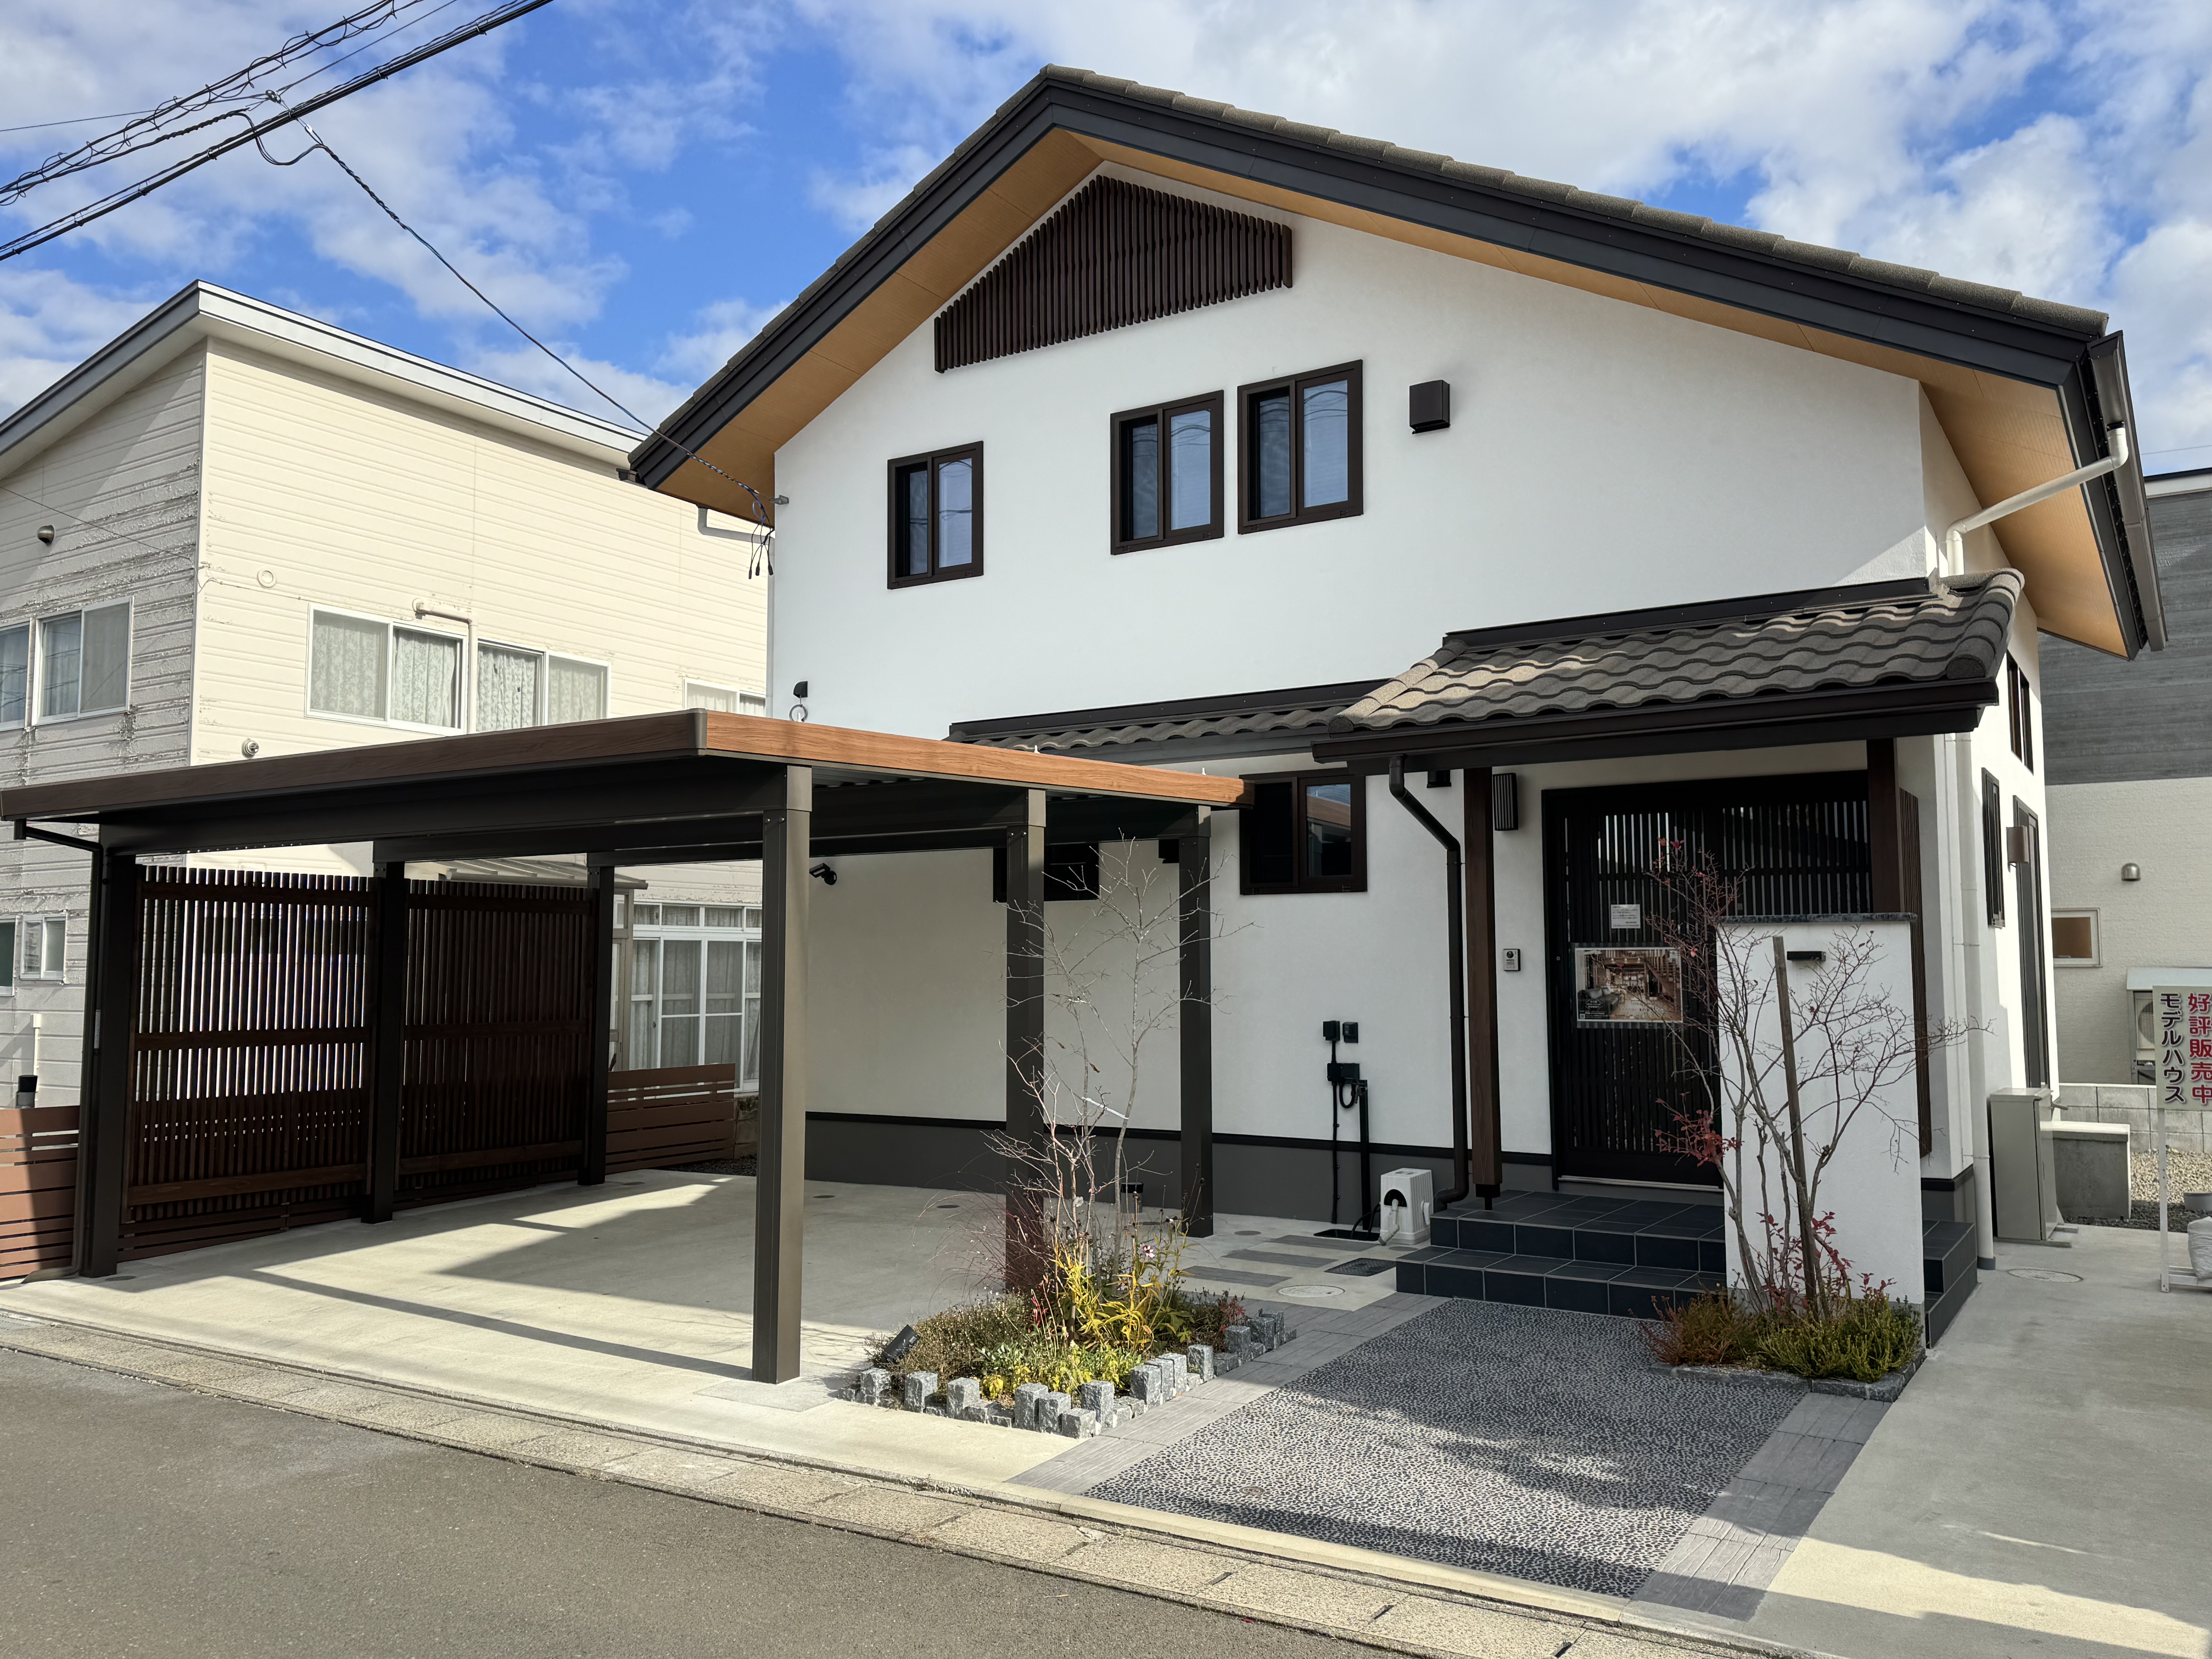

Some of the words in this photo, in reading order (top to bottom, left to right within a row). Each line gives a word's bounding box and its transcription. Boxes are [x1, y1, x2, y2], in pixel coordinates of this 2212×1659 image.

[2160, 993, 2185, 1103] モデルハウス
[2188, 993, 2212, 1104] 好評販売中
